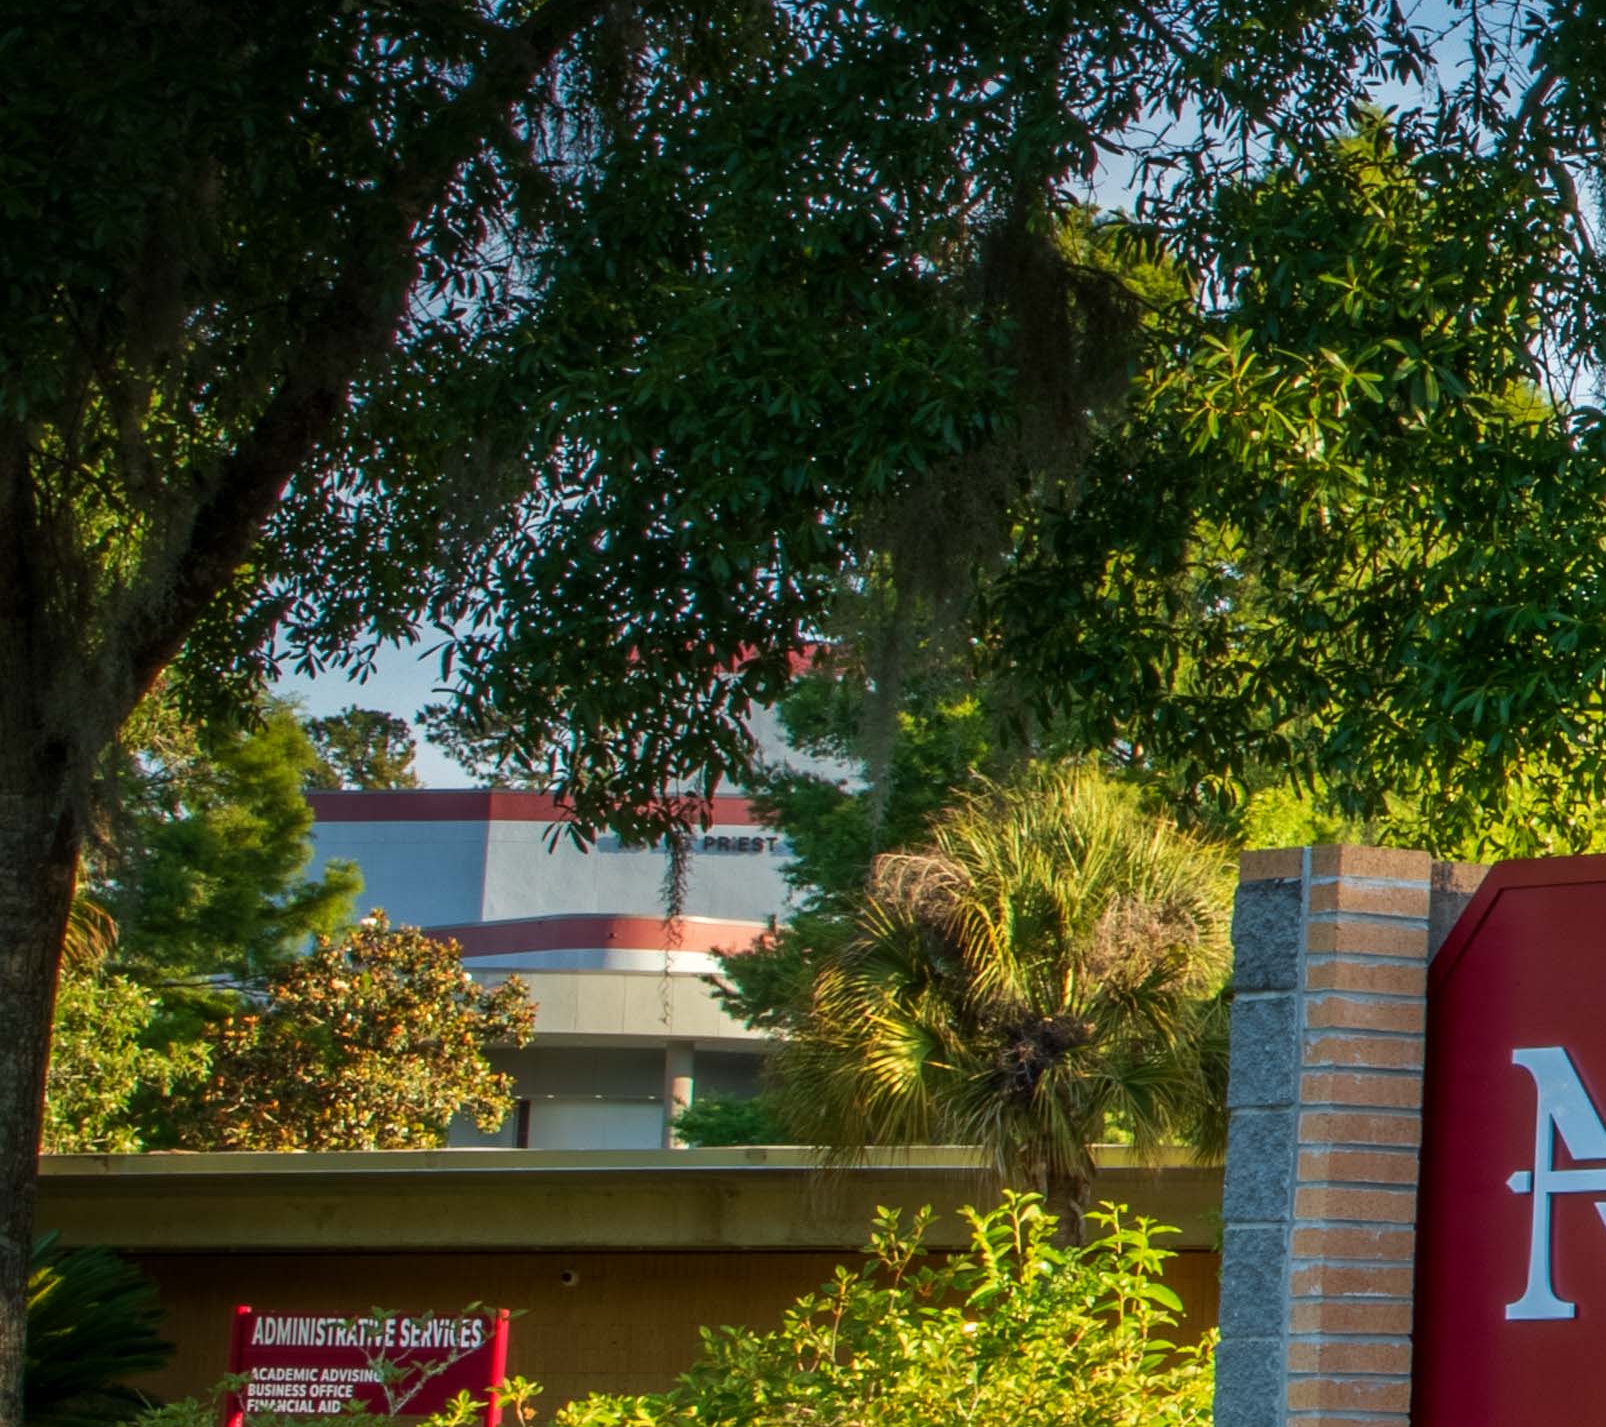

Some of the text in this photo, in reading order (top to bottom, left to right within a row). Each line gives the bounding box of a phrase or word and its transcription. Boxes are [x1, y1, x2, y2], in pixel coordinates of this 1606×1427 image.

[702, 835, 778, 853] PRIEST
[251, 1366, 319, 1382] ACADEMIC
[247, 1383, 354, 1398] BUSINESS OFFICE
[317, 1400, 342, 1413] AID
